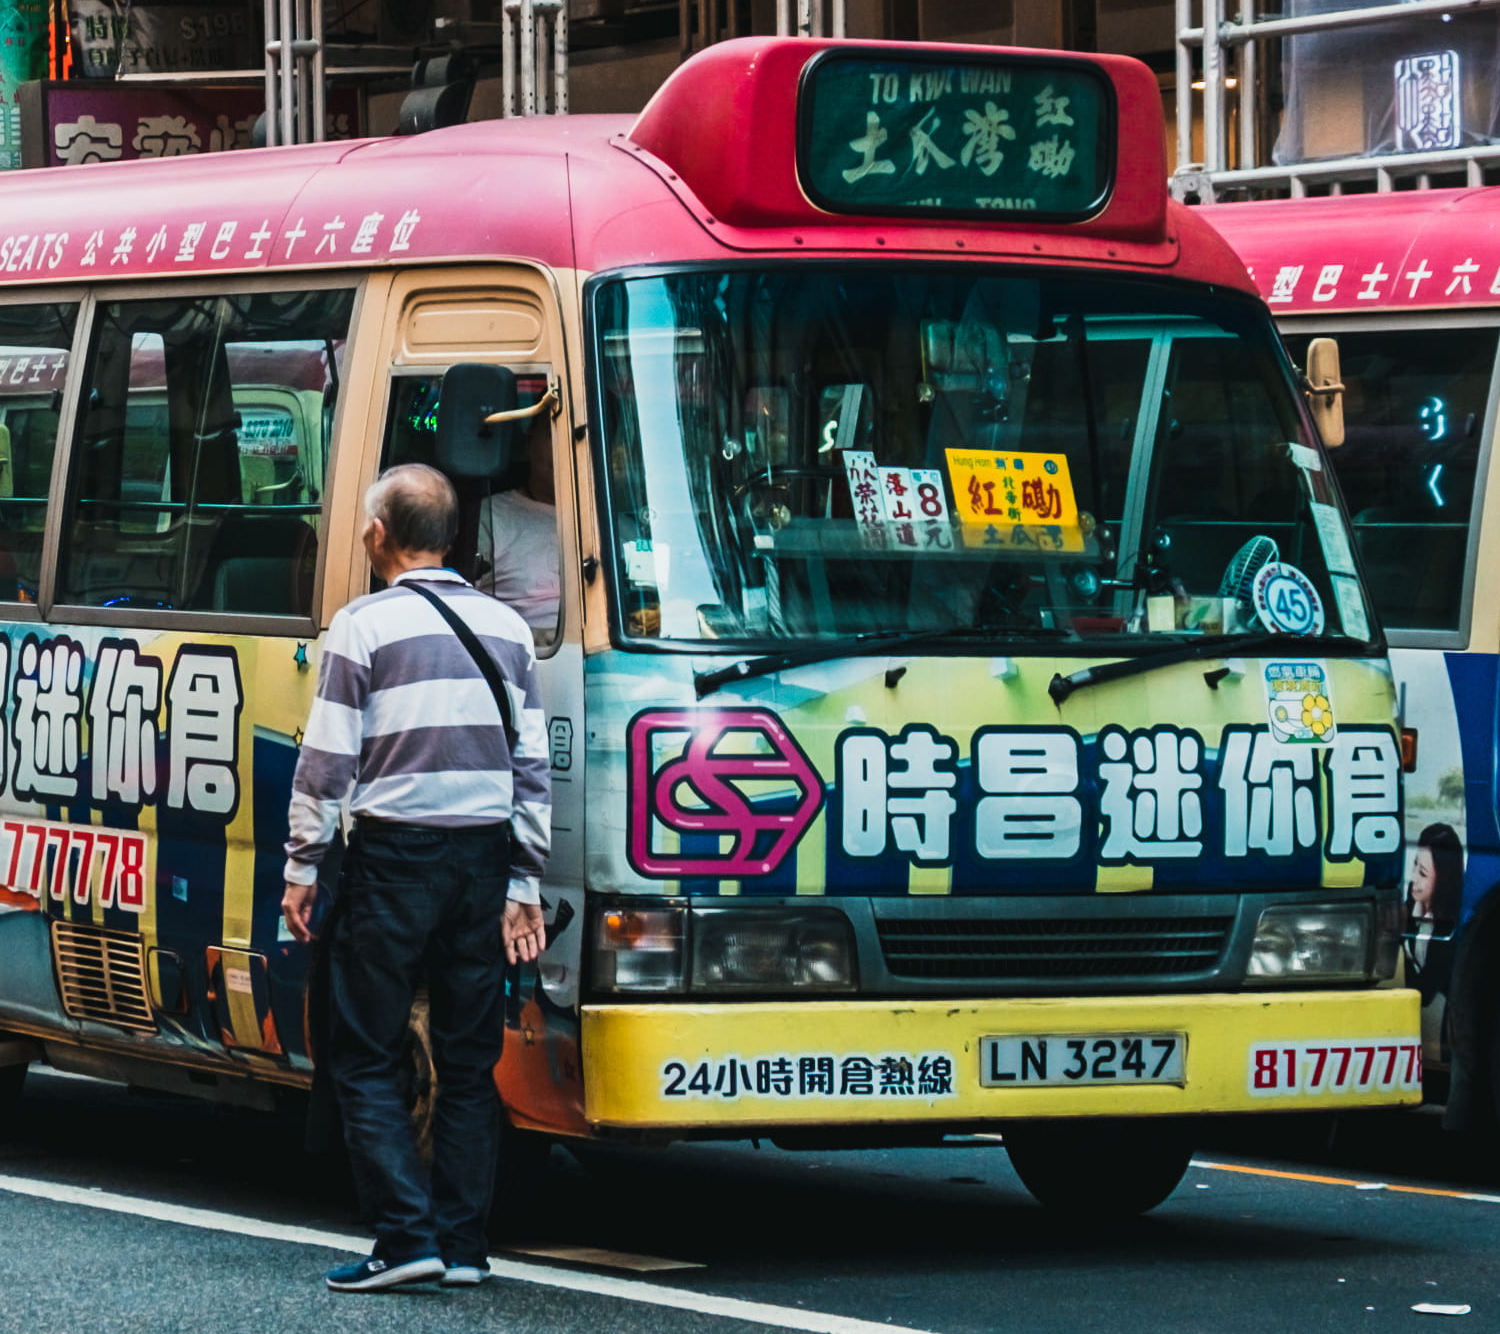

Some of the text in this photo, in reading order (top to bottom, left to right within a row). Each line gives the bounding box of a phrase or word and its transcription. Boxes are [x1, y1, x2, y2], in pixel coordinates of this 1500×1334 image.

[870, 73, 898, 104] TO
[79, 208, 421, 265] 公共小型巴士十六座位
[1276, 589, 1307, 624] 45
[839, 730, 1400, 862] 時昌迷你倉
[664, 1056, 953, 1097] 24小時開倉熱線
[988, 1037, 1174, 1080] LN 3247
